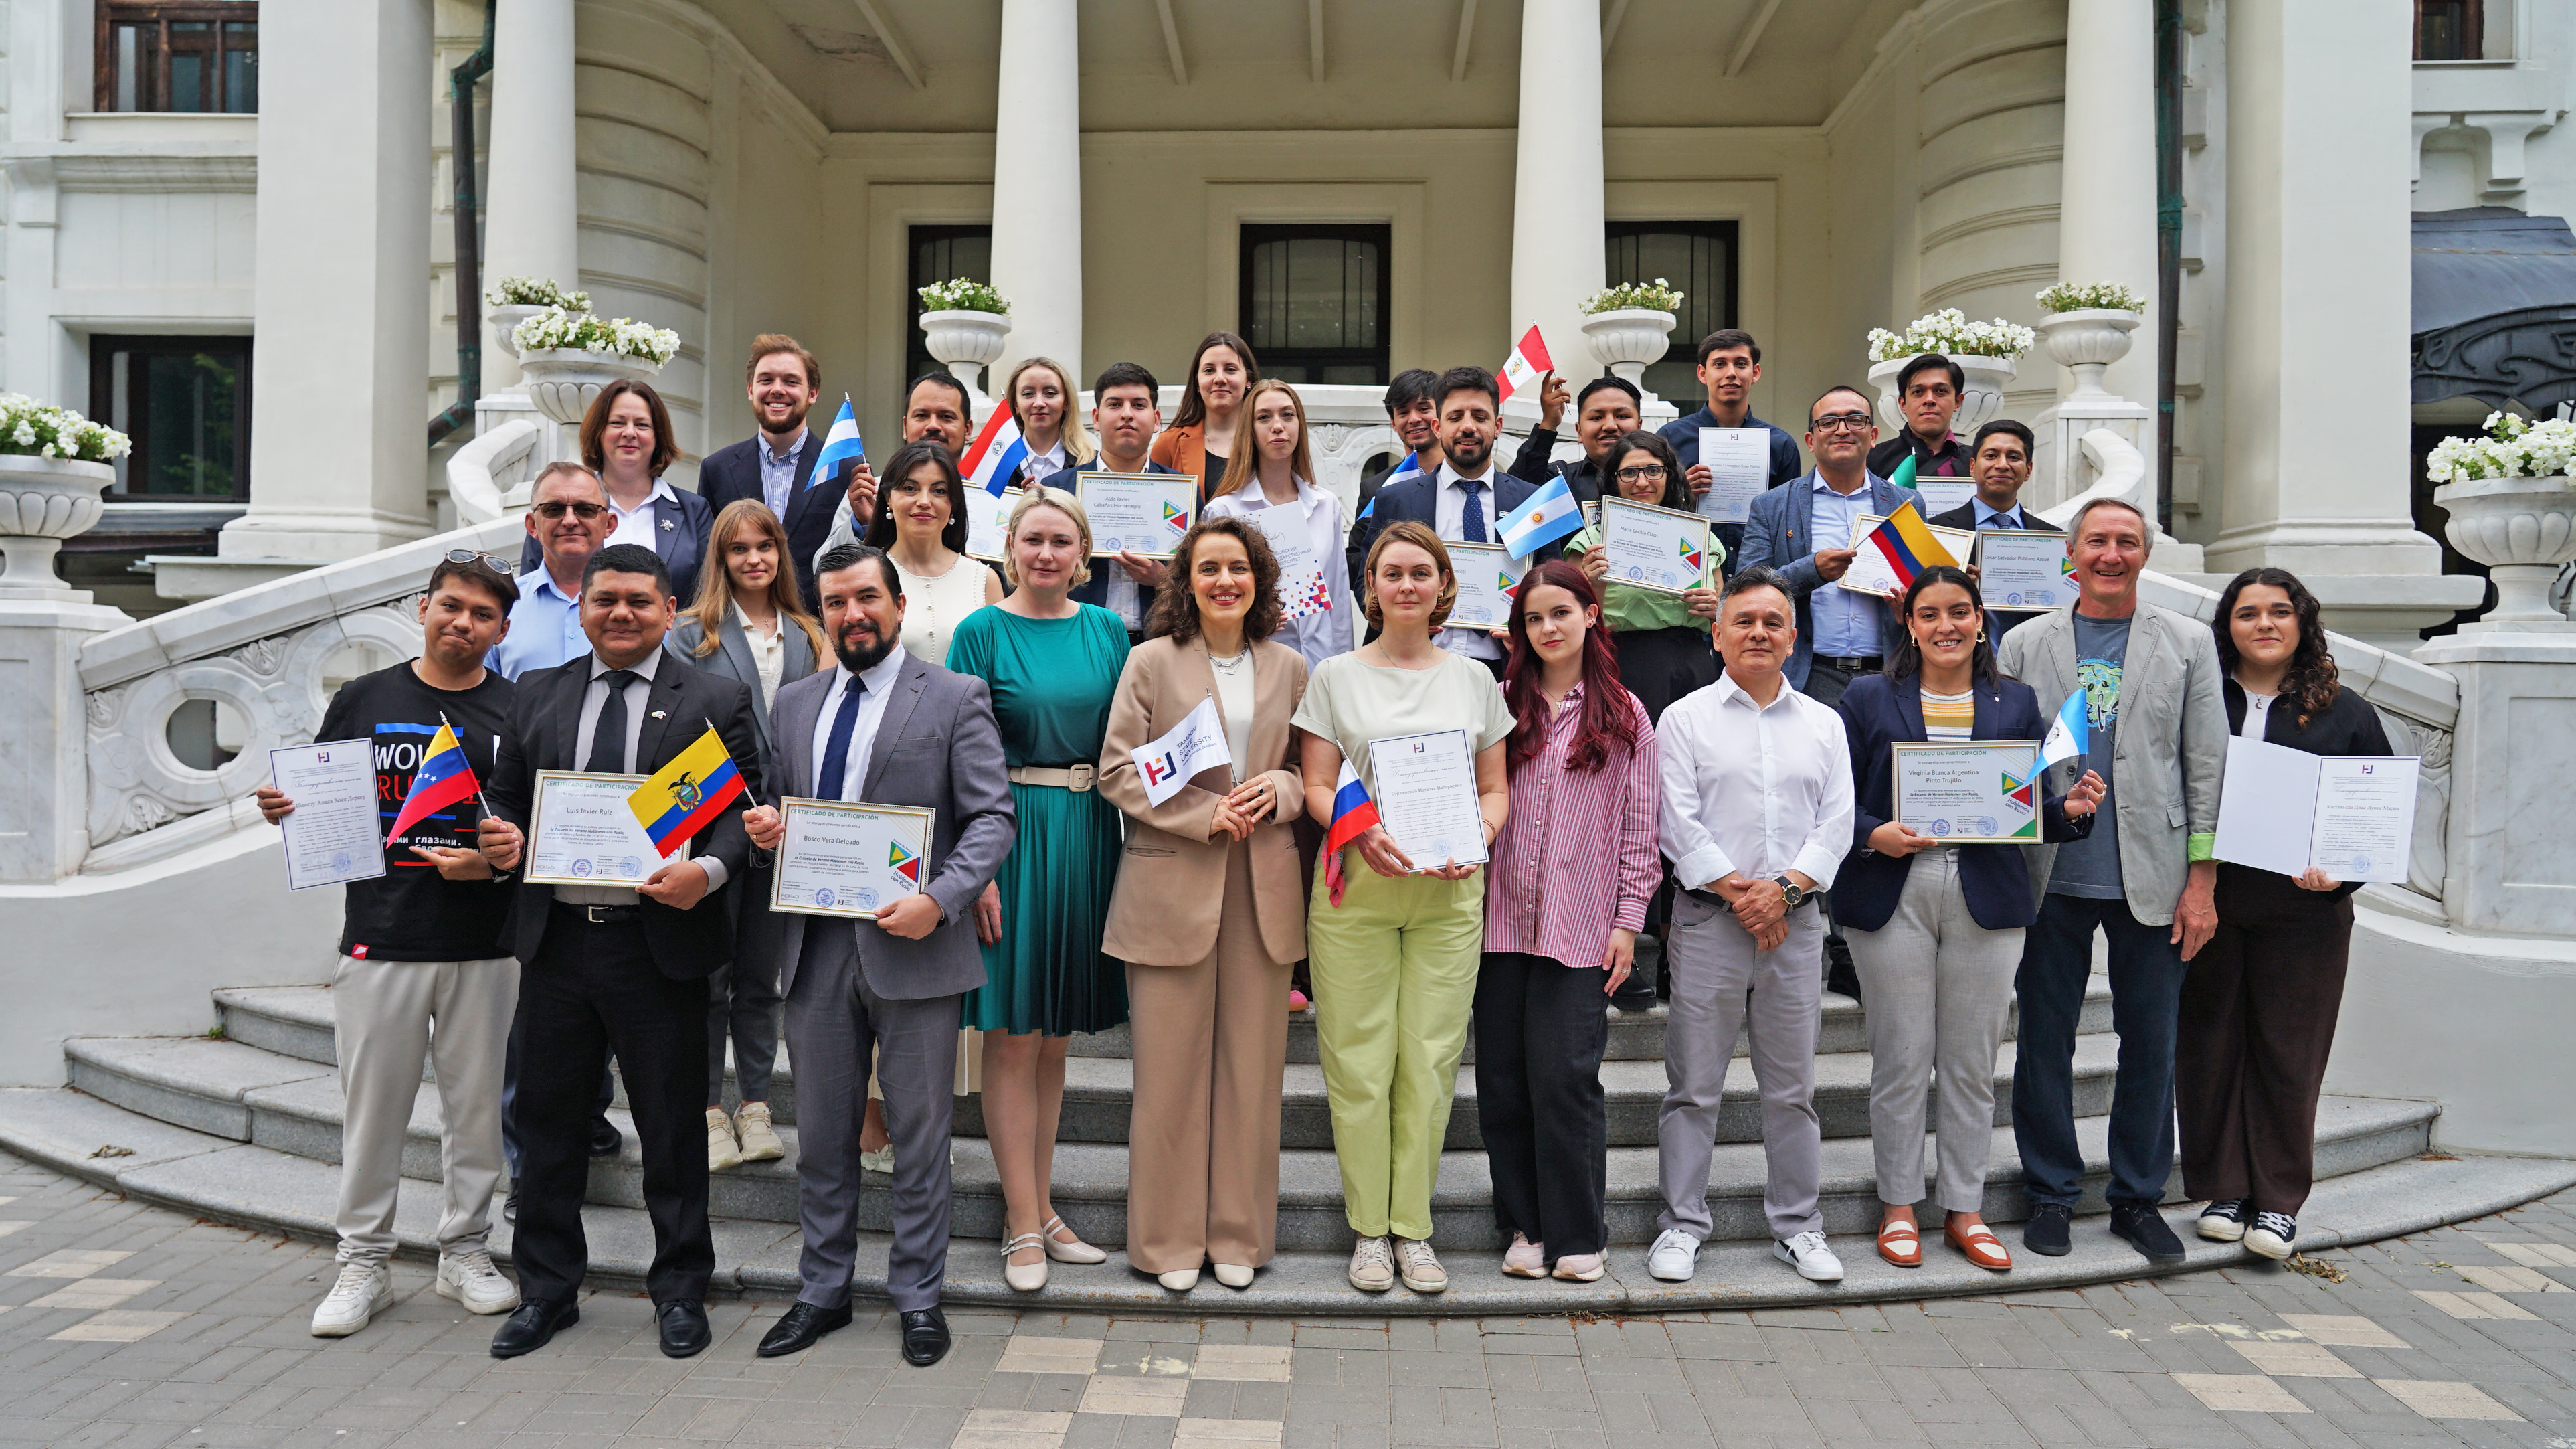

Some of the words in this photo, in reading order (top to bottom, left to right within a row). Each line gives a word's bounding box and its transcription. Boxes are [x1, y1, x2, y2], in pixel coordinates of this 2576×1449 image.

[1609, 505, 1635, 513] CERTIFICADO
[1642, 512, 1671, 521] PARTICIPACIÓN
[1177, 725, 1196, 748] TAMBOV
[1179, 737, 1193, 755] STATE
[1181, 735, 1211, 761] UNIVERSITY
[2008, 798, 2030, 813] Hablemos
[2014, 806, 2026, 816] Rusia
[837, 812, 879, 820] PARTICIPACIÓN
[415, 837, 461, 846] глазами.
[836, 838, 860, 846] Delgado
[893, 871, 914, 888] Hablemos
[899, 881, 910, 891] Rusia
